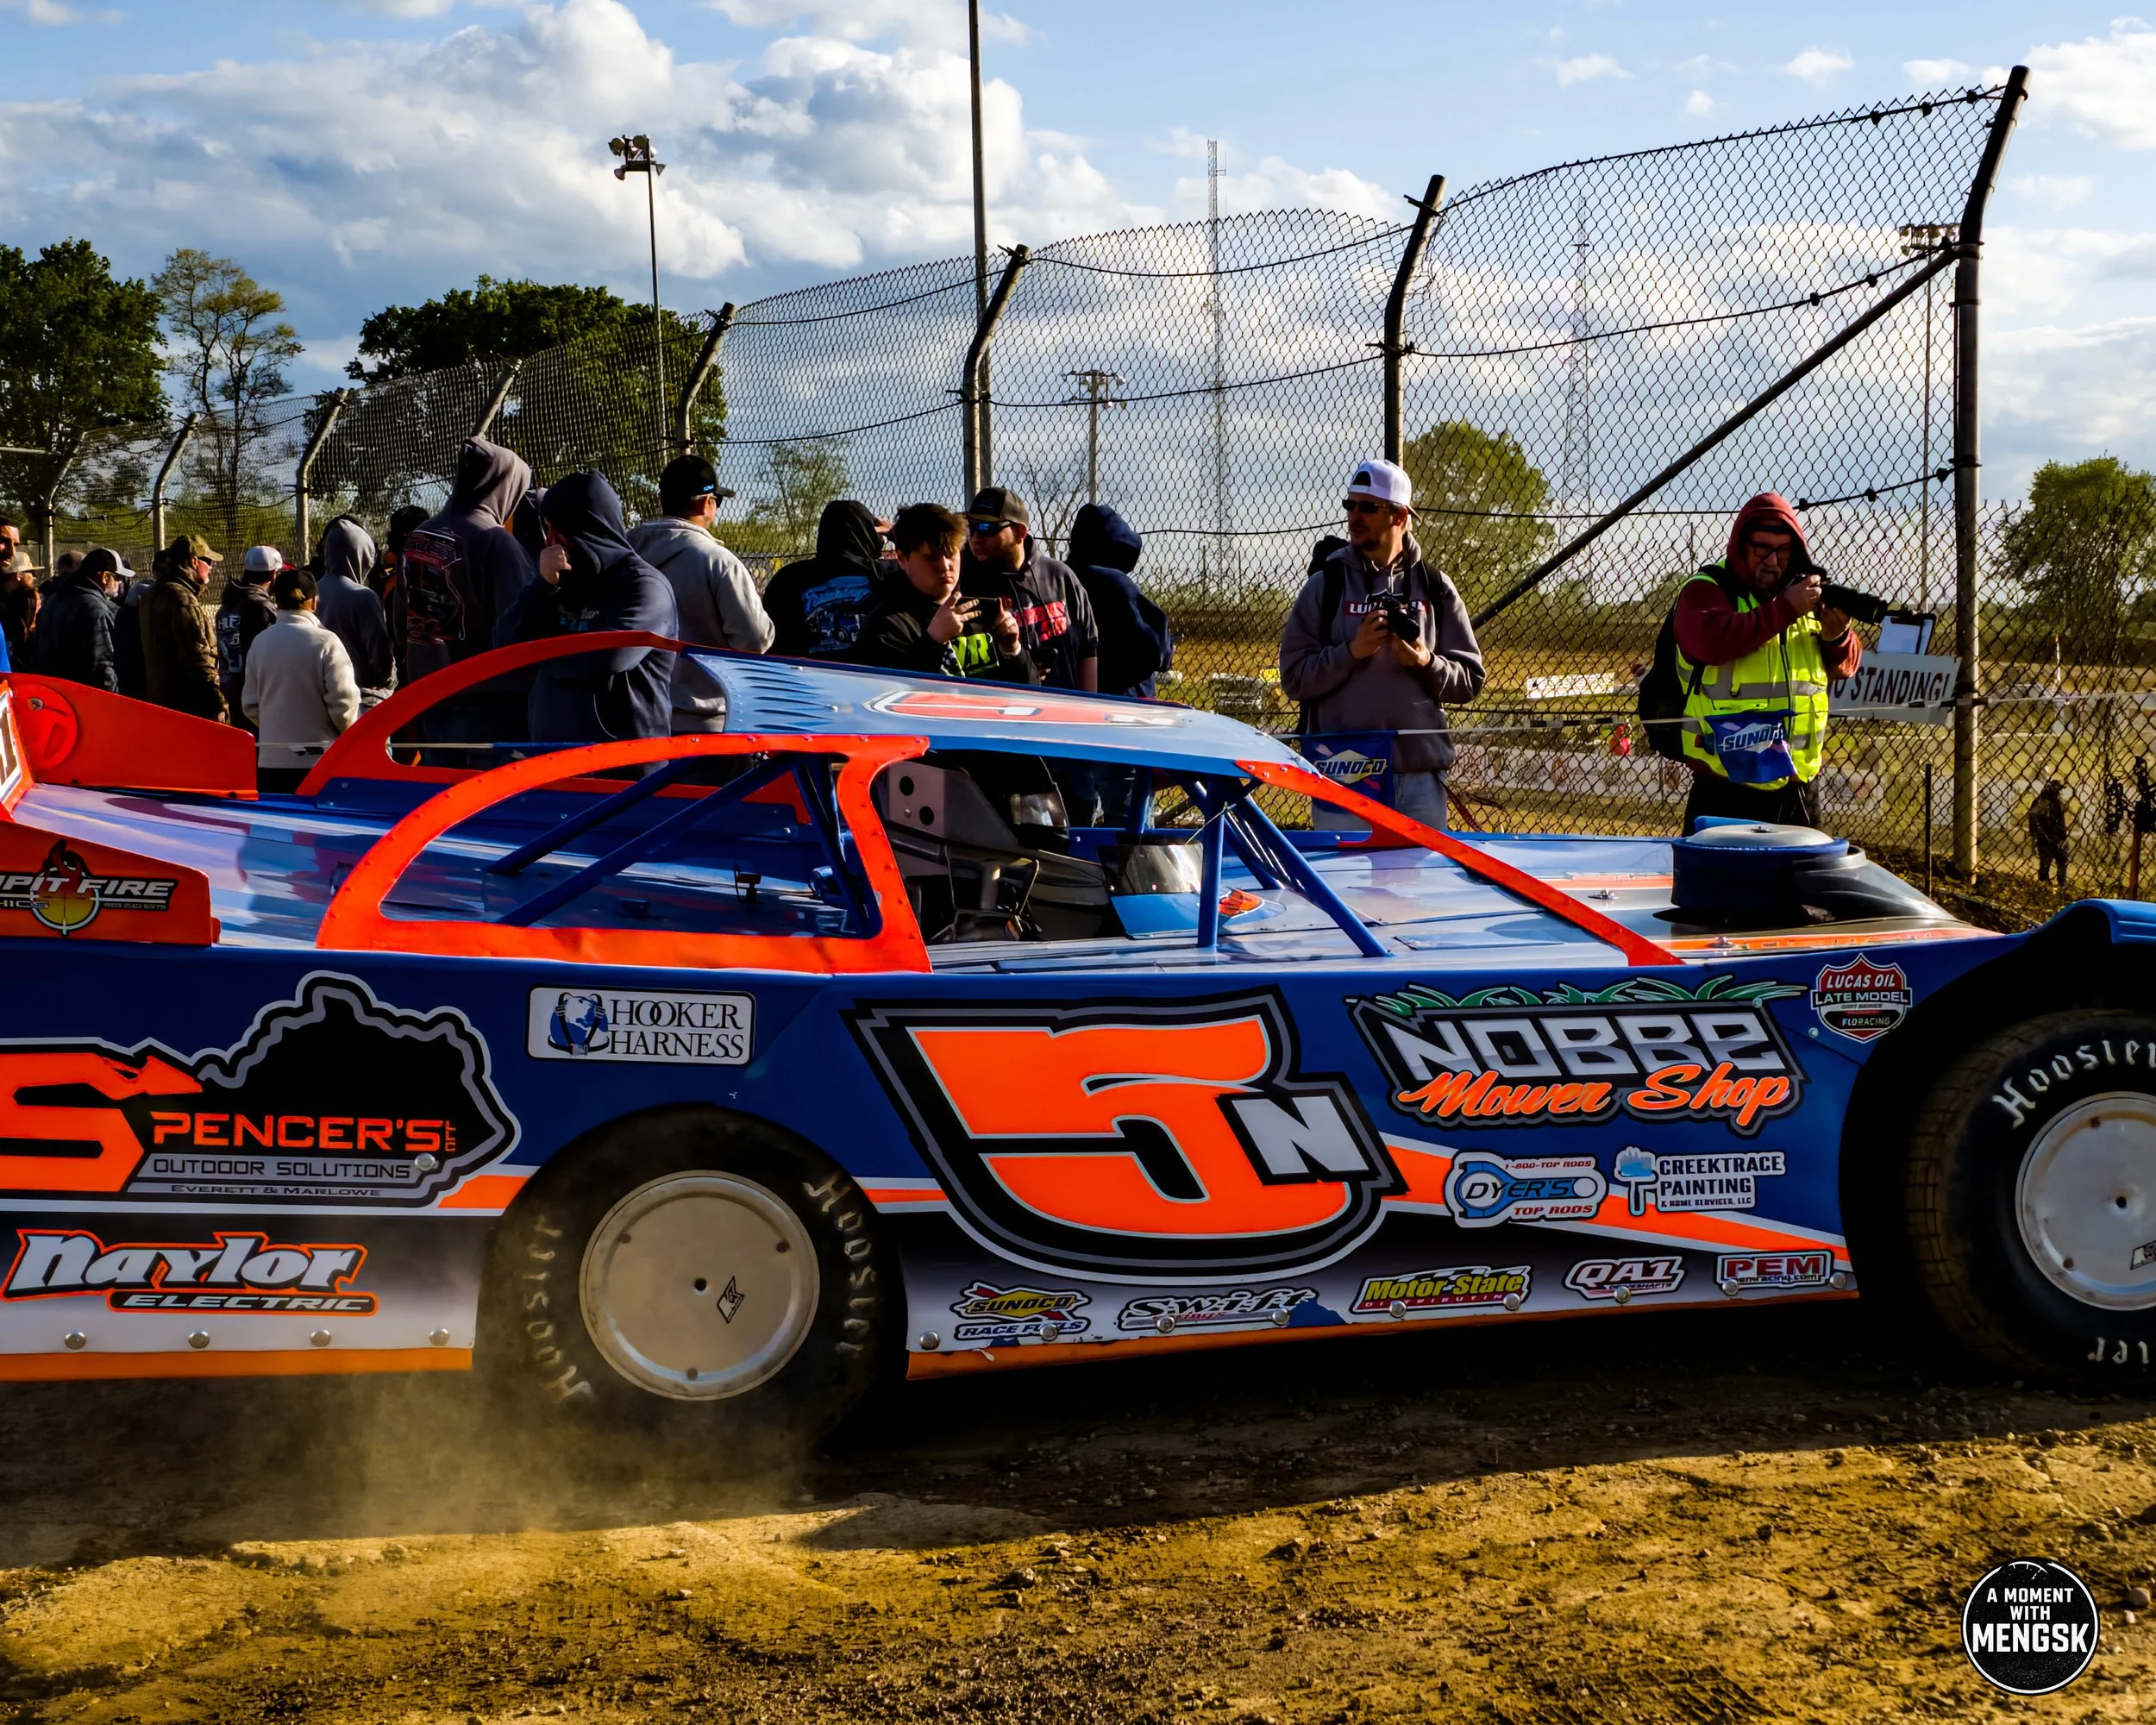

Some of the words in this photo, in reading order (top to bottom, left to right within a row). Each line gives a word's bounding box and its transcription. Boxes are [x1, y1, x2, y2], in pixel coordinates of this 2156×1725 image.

[1851, 666, 1951, 705] STANDING!
[1316, 760, 1384, 775] SUNOCO
[0, 875, 70, 893] PIT
[77, 878, 174, 897] FIRE
[1827, 975, 1871, 989] LUCAS
[1874, 974, 1896, 988] OIL
[1815, 993, 1852, 1006] LATE
[1856, 992, 1908, 1003] MODEL
[610, 999, 745, 1030] HOOKER
[1842, 1018, 1890, 1026] FLORACING
[607, 1031, 744, 1059] HARNESS
[1383, 1012, 1785, 1081] NOBBE
[1397, 1070, 1613, 1118] Mower
[1626, 1061, 1791, 1126] Shop
[154, 1158, 265, 1176] OUTDOOR
[277, 1161, 411, 1179] SOLUTIONS
[1563, 1160, 1592, 1169] RODS
[1659, 1156, 1783, 1176] CREEKTRACE
[1465, 1179, 1574, 1200] DYER'S
[1660, 1178, 1752, 1196] PAINTING
[1514, 1206, 1544, 1216] TOP
[1547, 1205, 1593, 1215] RODS
[1576, 1261, 1676, 1288] QA1
[1726, 1256, 1823, 1277] PEM
[1735, 1273, 1820, 1283] emracing.com
[1364, 1280, 1449, 1301] Motor
[1452, 1275, 1525, 1294] State
[120, 1295, 370, 1311] ELECTRIC
[970, 1296, 1075, 1313] SUNOCO
[1365, 1294, 1504, 1308] DITRIBUTIN
[962, 1325, 1018, 1336] RACE
[1022, 1321, 1084, 1334] FULS
